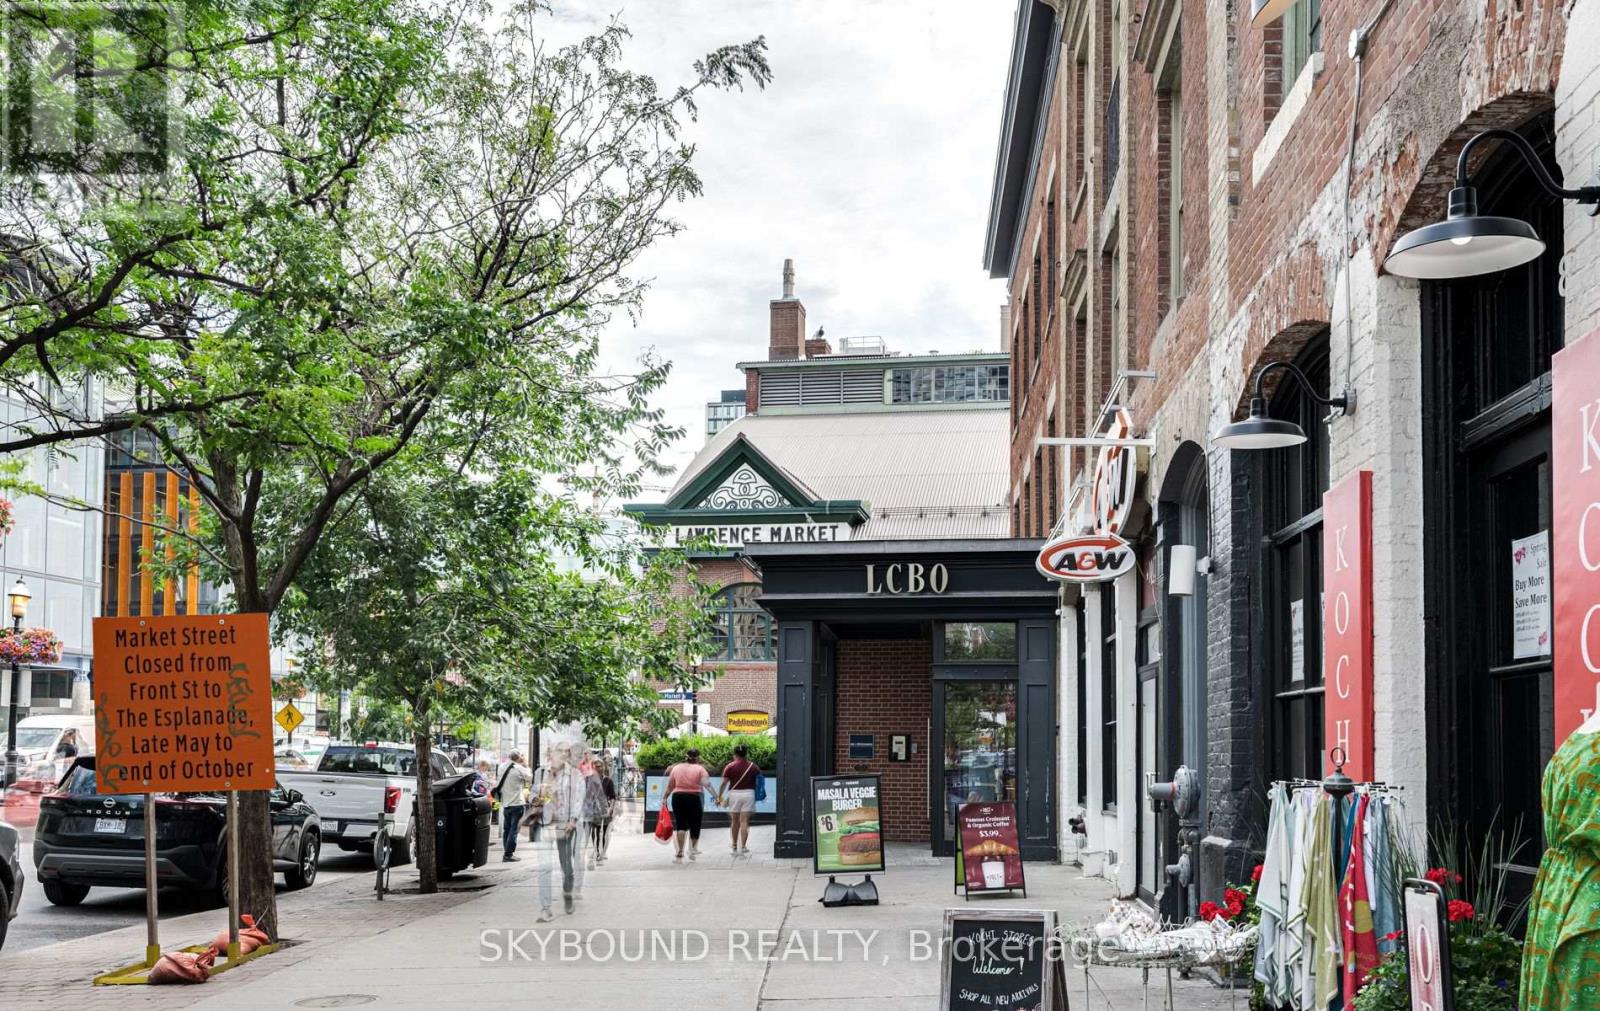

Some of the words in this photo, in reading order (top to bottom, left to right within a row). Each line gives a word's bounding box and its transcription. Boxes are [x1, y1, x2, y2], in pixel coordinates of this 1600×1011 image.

[769, 525, 839, 542] MARKET
[1055, 551, 1129, 571] A&W
[866, 563, 950, 595] LCBO
[1515, 579, 1527, 592] Buy
[1528, 575, 1545, 588] More
[1515, 597, 1529, 610] Save
[1530, 593, 1548, 605] More
[115, 627, 177, 648] Market
[182, 625, 237, 646] Street
[124, 653, 184, 674] Closed
[190, 652, 232, 672] from
[130, 681, 177, 701] Front
[182, 680, 199, 699] St
[203, 680, 221, 699] to
[116, 707, 148, 728] The
[154, 705, 254, 731] Esplanade,
[131, 735, 169, 755] Late
[176, 734, 210, 757] May
[215, 732, 233, 752] to
[119, 761, 152, 782] end
[159, 759, 176, 780] of
[182, 757, 253, 780] October
[817, 787, 849, 801] MASALA
[849, 786, 877, 799] VEGGIE
[832, 798, 862, 811] BURGER
[821, 815, 834, 832] $6
[959, 988, 979, 1003] SHOP
[980, 994, 992, 1005] ALL
[995, 992, 1010, 1005] NEW
[1011, 982, 1040, 1003] ARRIVALS
